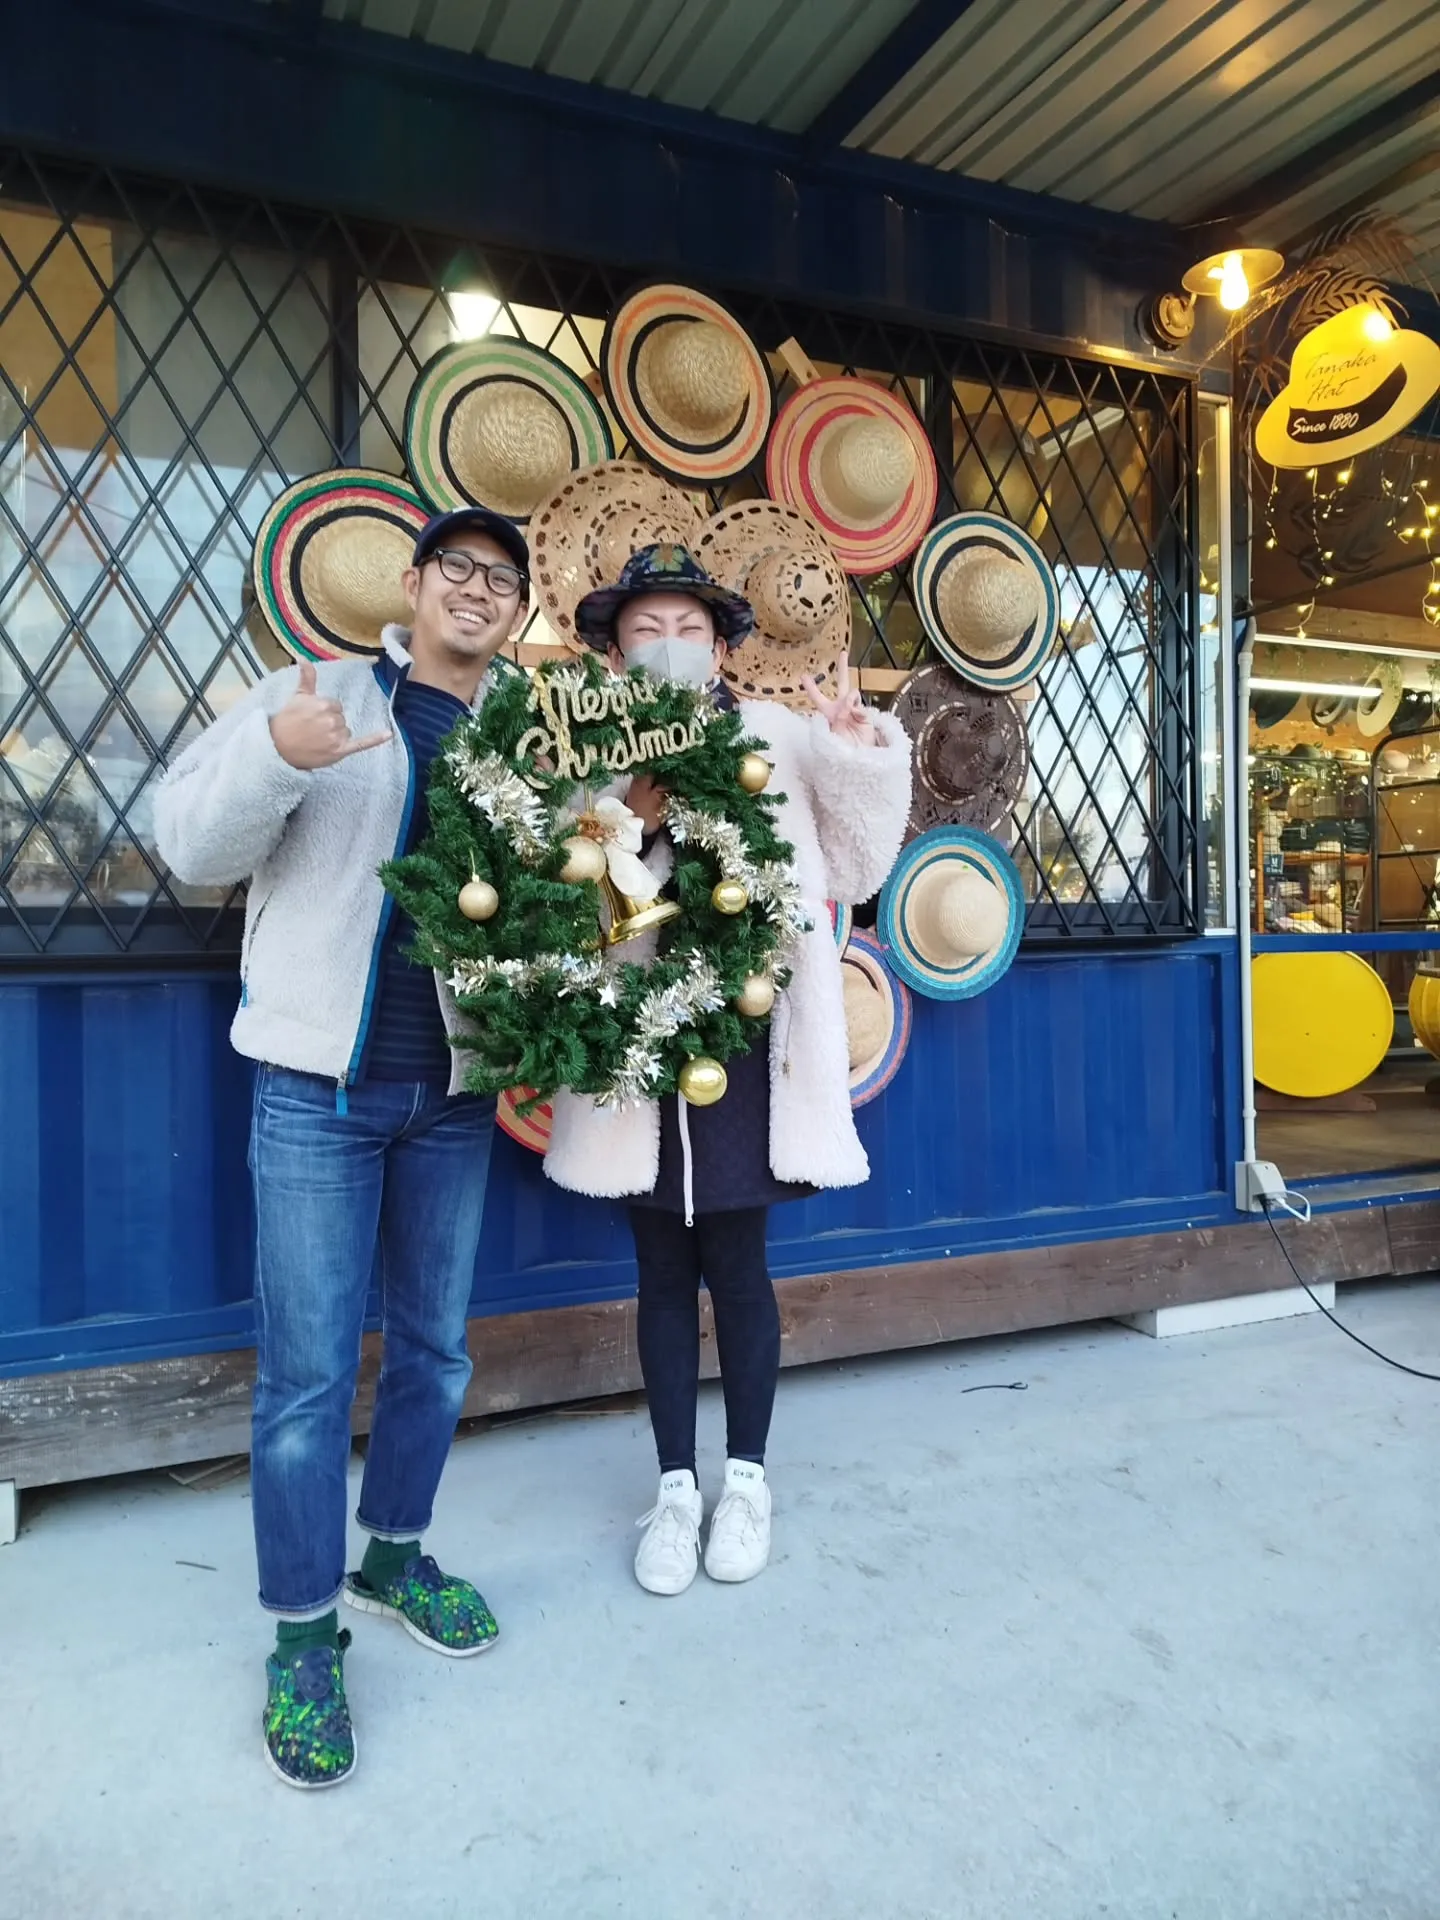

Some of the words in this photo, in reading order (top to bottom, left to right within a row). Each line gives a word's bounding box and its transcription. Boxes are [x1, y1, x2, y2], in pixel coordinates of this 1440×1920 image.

[1305, 349, 1377, 380] Tanaka
[1307, 376, 1360, 404] Hat
[1291, 417, 1326, 436] Since
[1329, 413, 1359, 430] 1880
